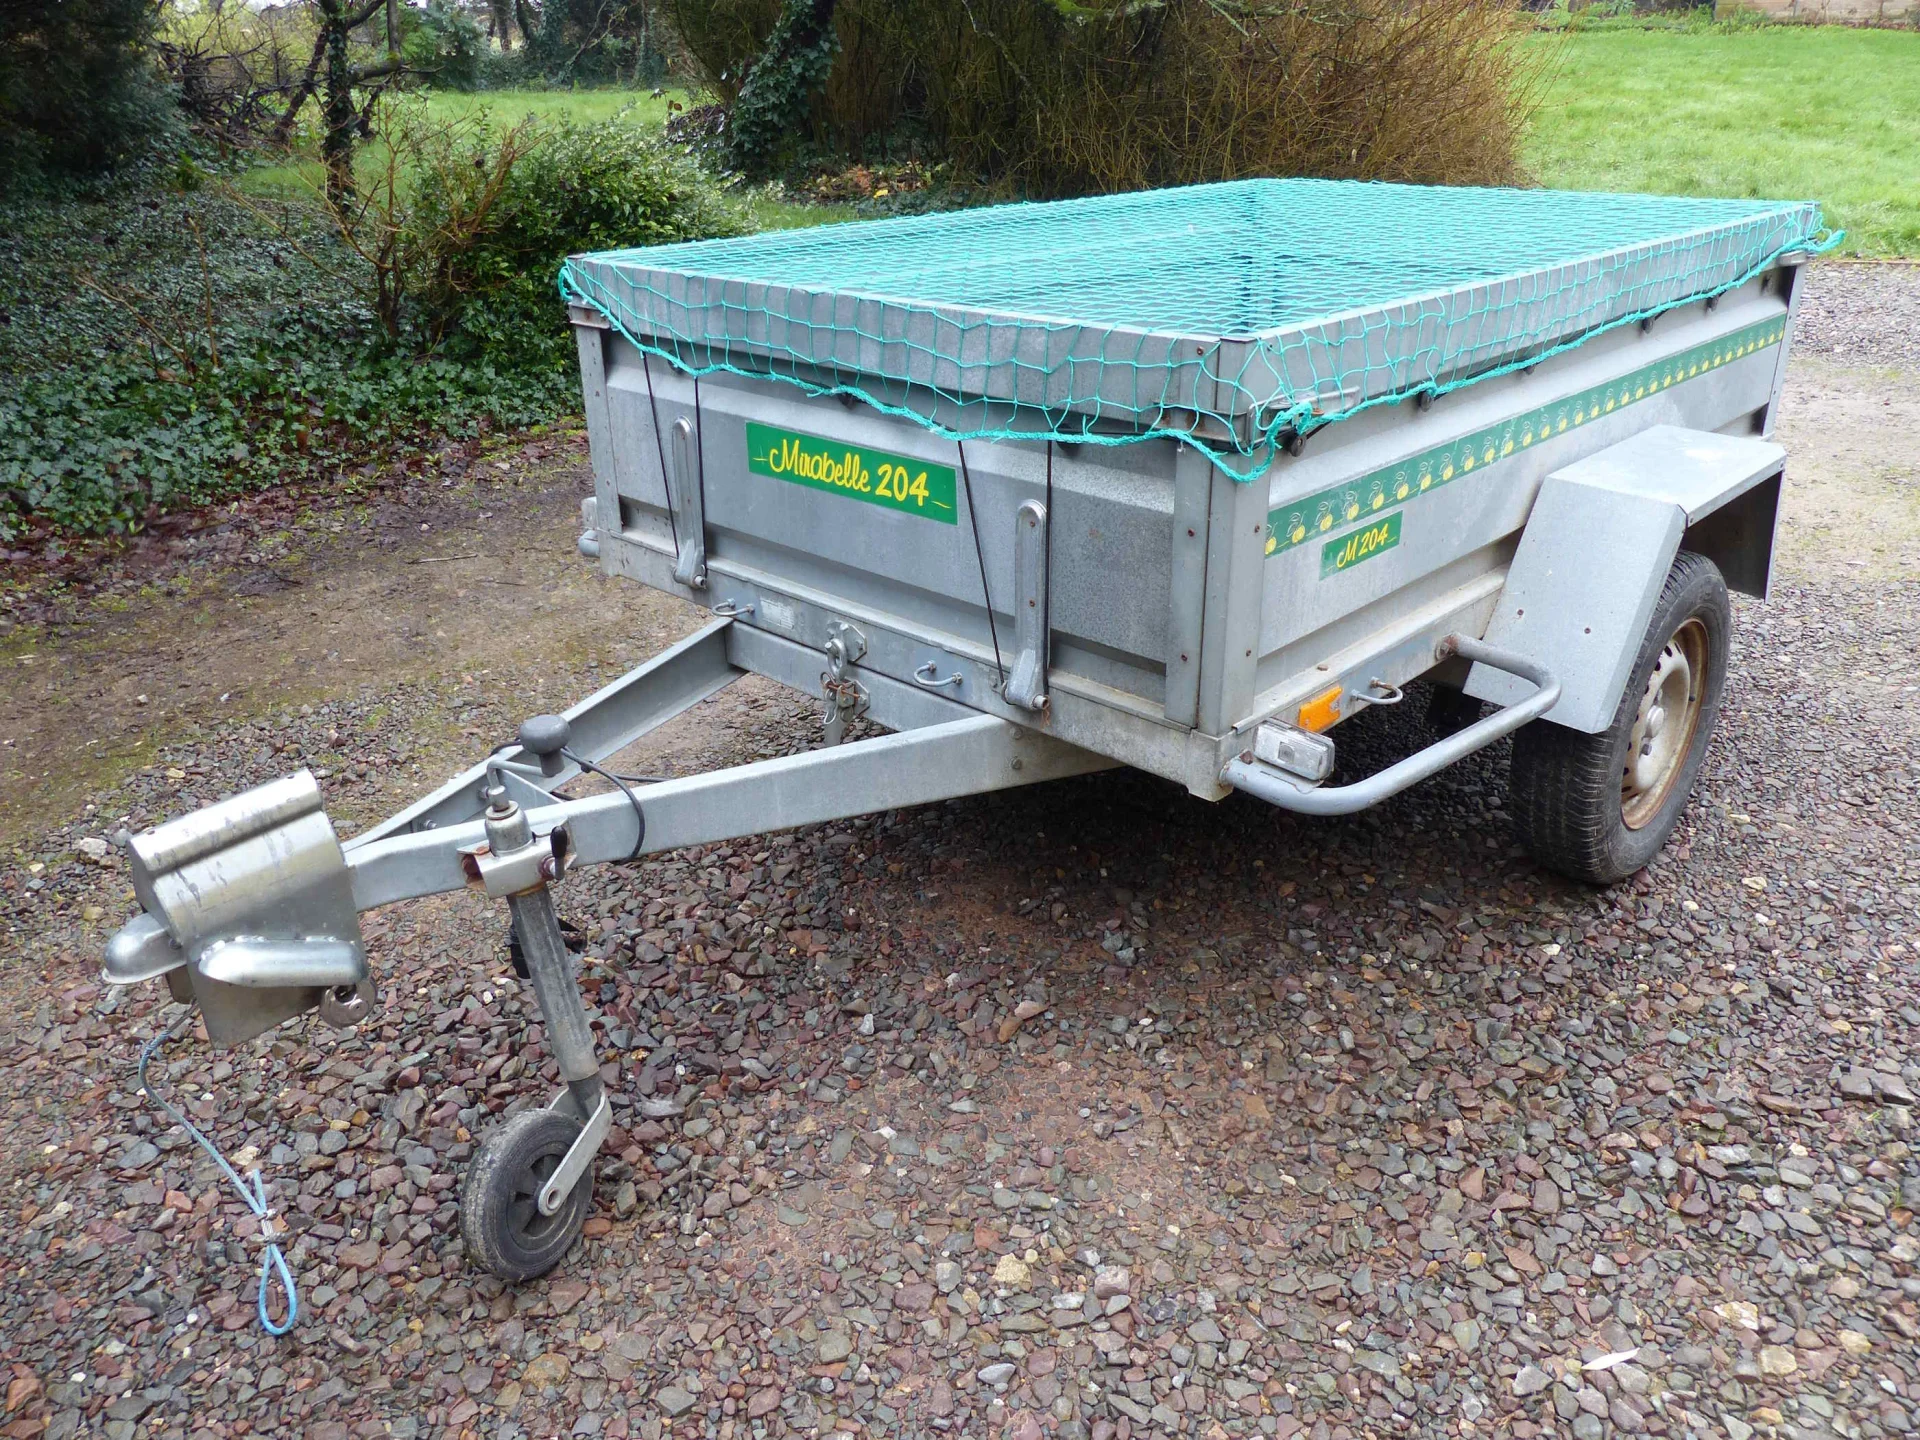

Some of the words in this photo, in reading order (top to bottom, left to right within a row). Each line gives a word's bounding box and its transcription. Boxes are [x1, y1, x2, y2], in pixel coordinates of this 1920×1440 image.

[769, 438, 870, 492] Mirabelle
[875, 464, 929, 506] 204
[1337, 536, 1358, 568] M
[1359, 523, 1389, 556] 204
